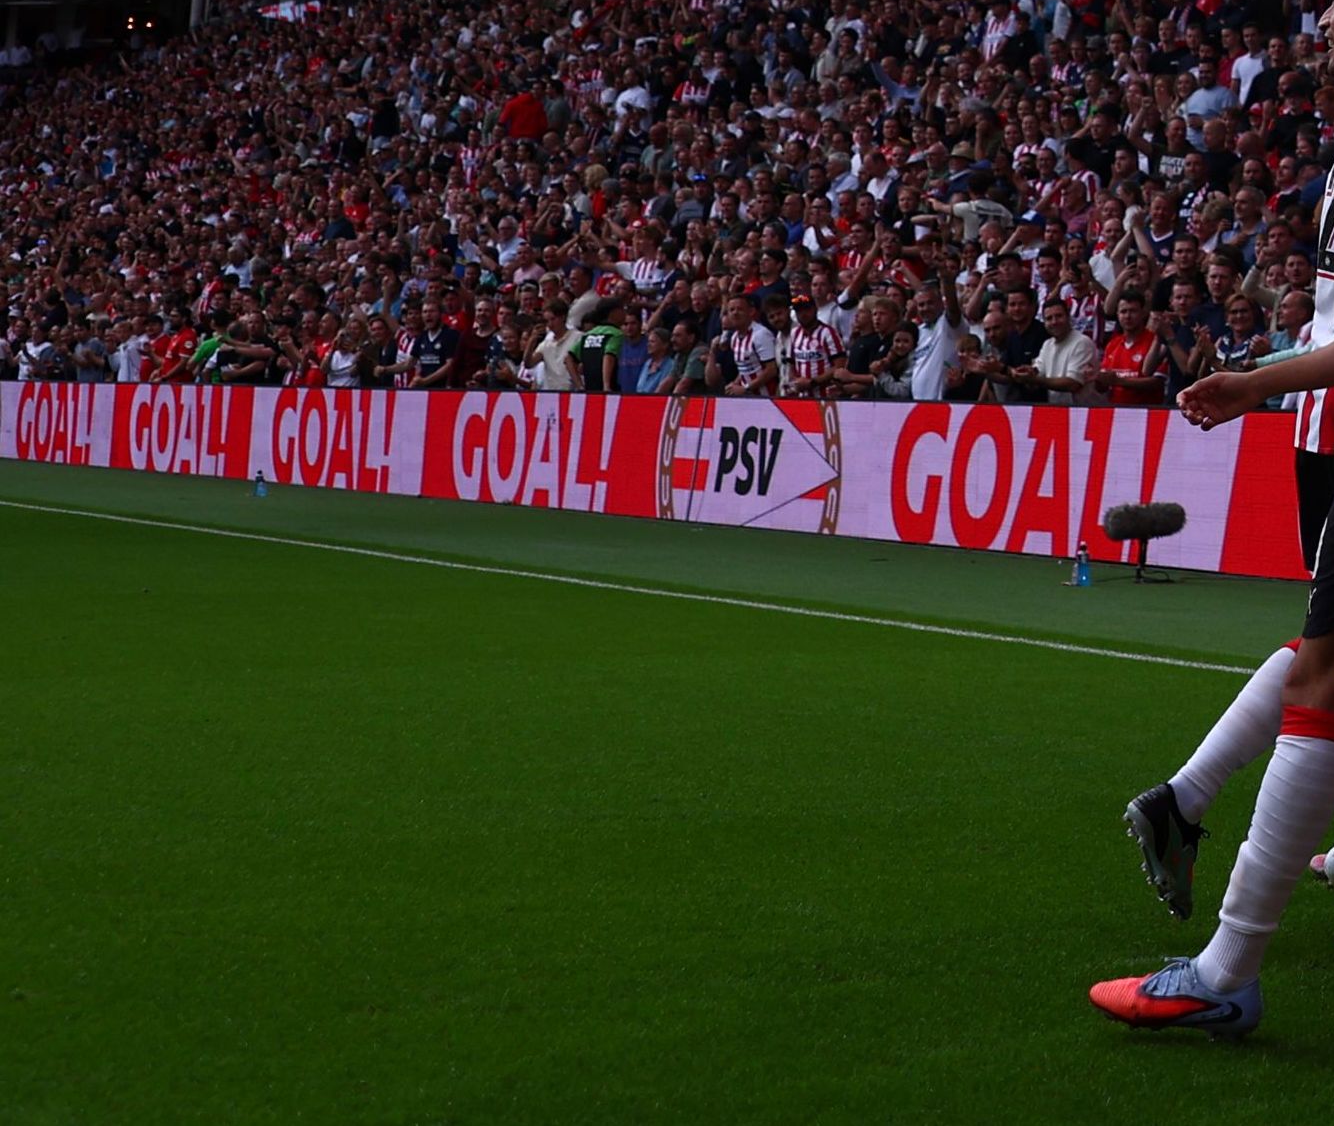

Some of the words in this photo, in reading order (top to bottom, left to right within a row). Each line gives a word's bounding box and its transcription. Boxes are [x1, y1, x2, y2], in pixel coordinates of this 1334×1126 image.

[16, 382, 98, 466] GOAL!
[129, 385, 230, 477] GOAL!
[271, 387, 397, 492] GOAL!
[452, 392, 620, 513] GOAL!
[714, 425, 783, 496] PSV
[892, 402, 1168, 564] GOAL!
